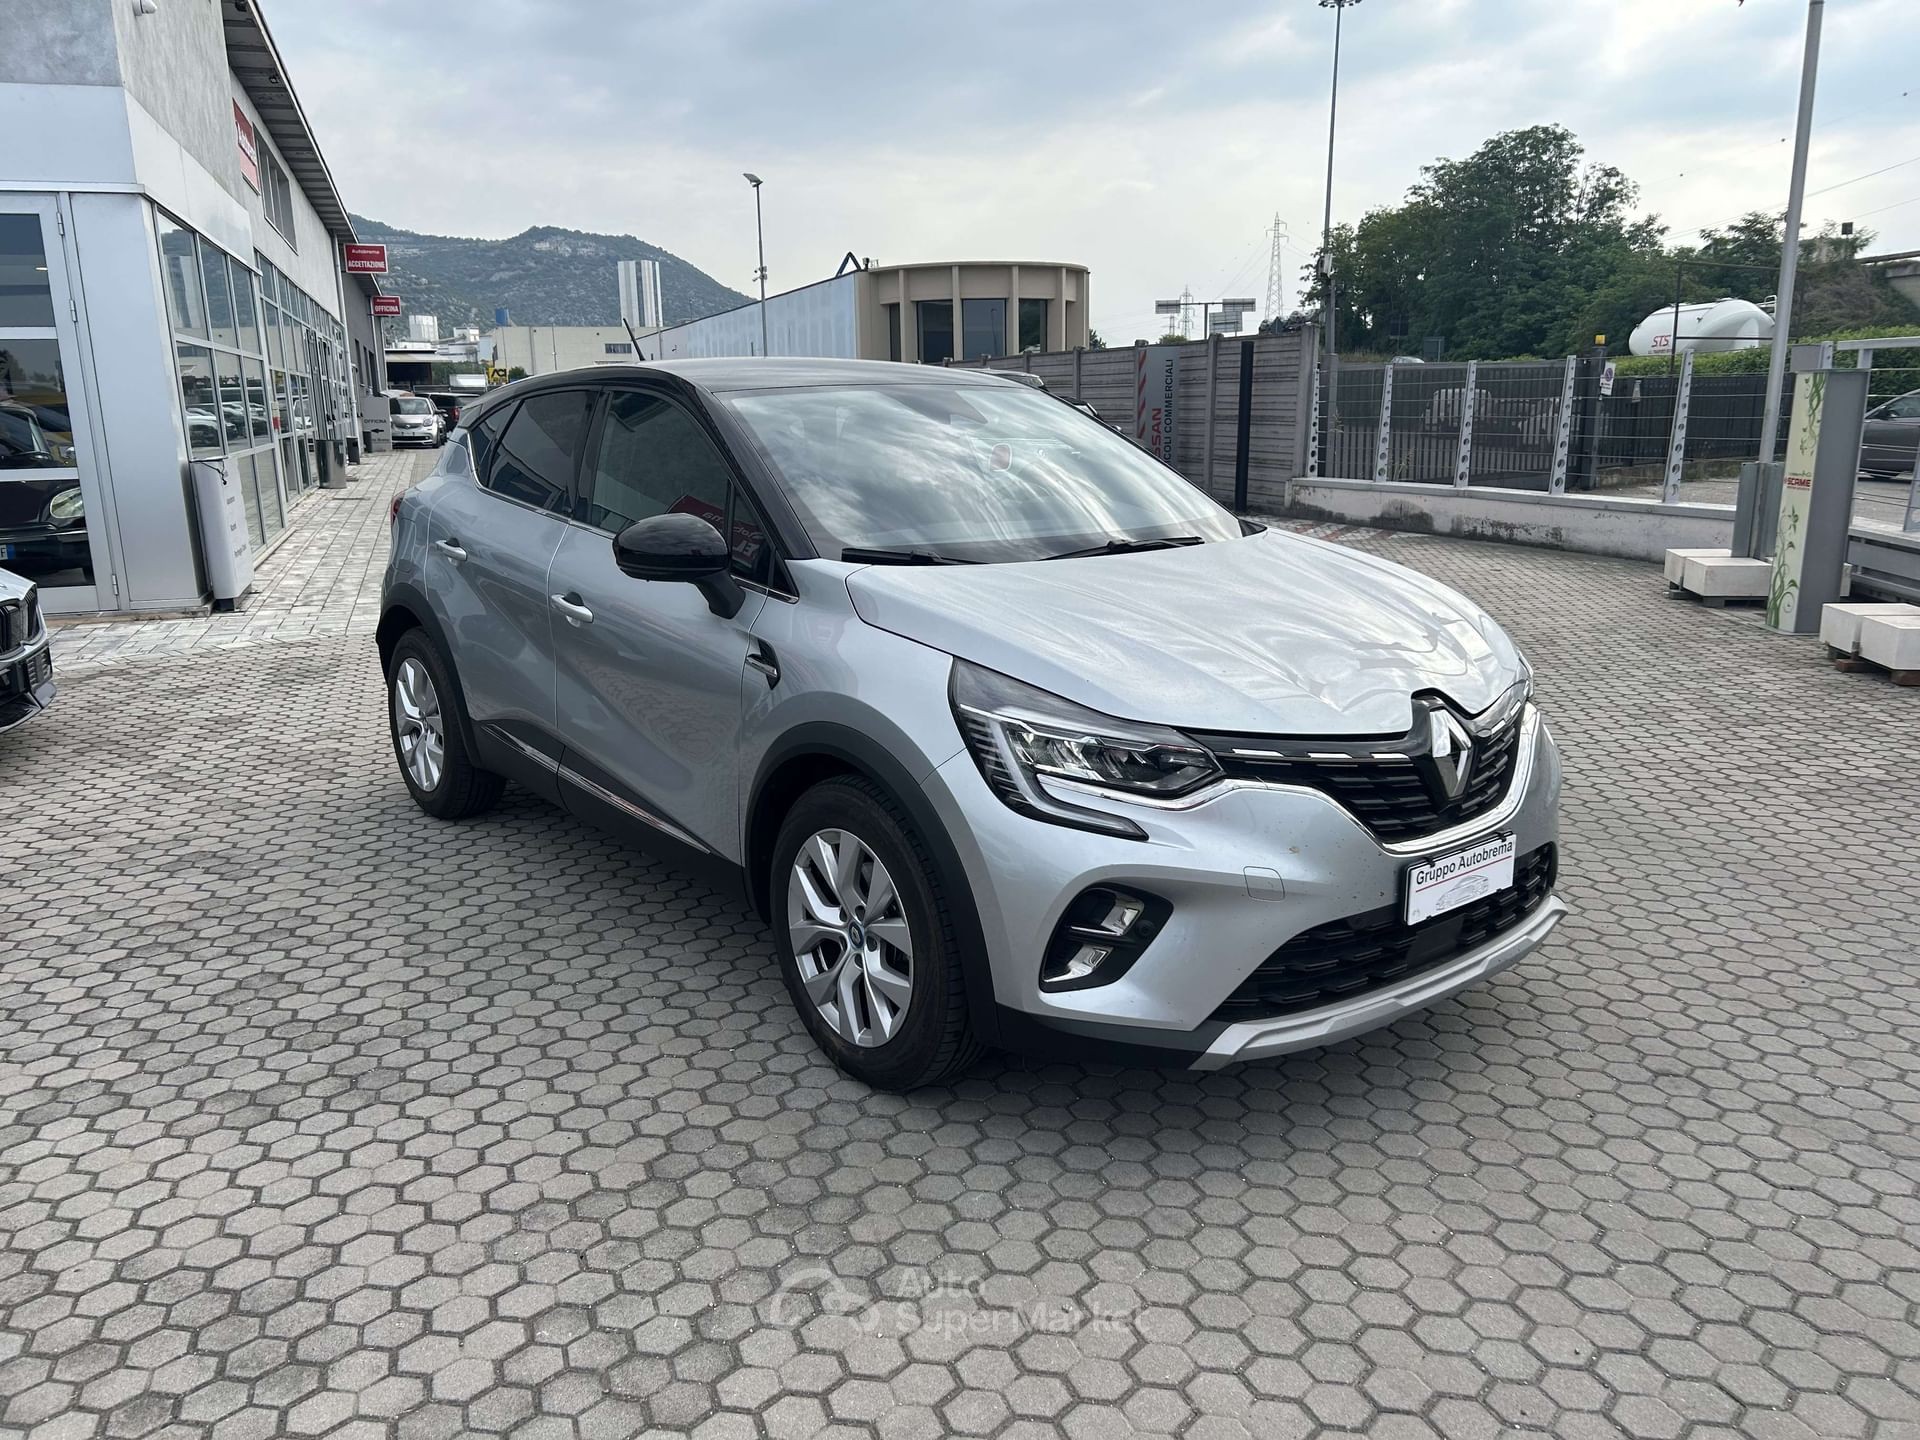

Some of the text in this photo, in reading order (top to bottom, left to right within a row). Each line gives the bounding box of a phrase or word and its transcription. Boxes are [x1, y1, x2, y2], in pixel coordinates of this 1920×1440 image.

[348, 260, 386, 269] ACCETTAZIONE
[374, 305, 399, 313] OFFICINA
[1651, 335, 1672, 348] STS
[1163, 359, 1174, 463] ICOLI COMMERCIALI
[1151, 408, 1162, 458] SSAN
[1416, 841, 1513, 885] Gruppo Autobrema
